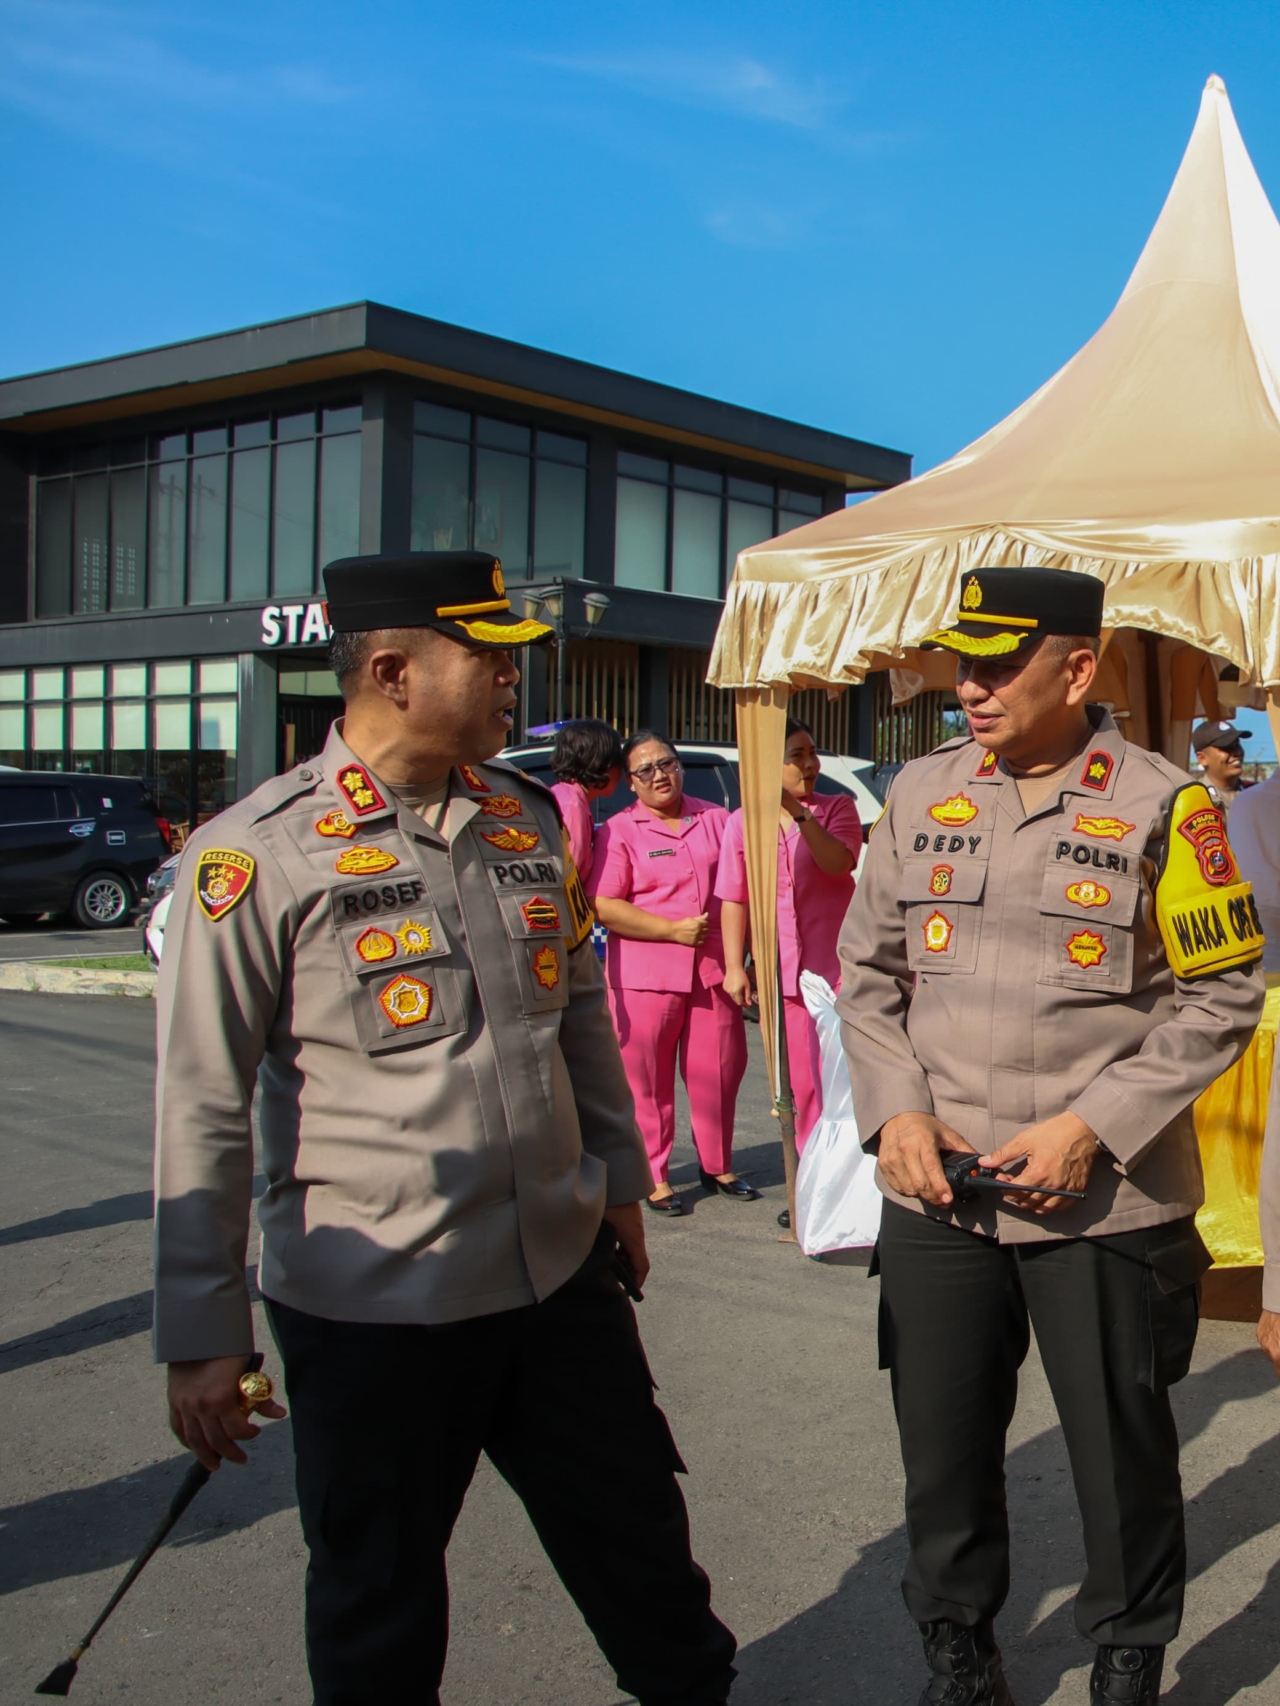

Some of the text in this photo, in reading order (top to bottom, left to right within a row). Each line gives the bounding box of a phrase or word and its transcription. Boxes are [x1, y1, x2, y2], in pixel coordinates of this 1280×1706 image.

[262, 603, 332, 646] STA
[204, 853, 250, 868] RESERSE
[913, 833, 982, 854] DEDY
[1055, 840, 1128, 874] POLRI
[493, 862, 558, 885] POLRI
[342, 880, 425, 915] ROSEF
[1172, 904, 1228, 958] WAKA
